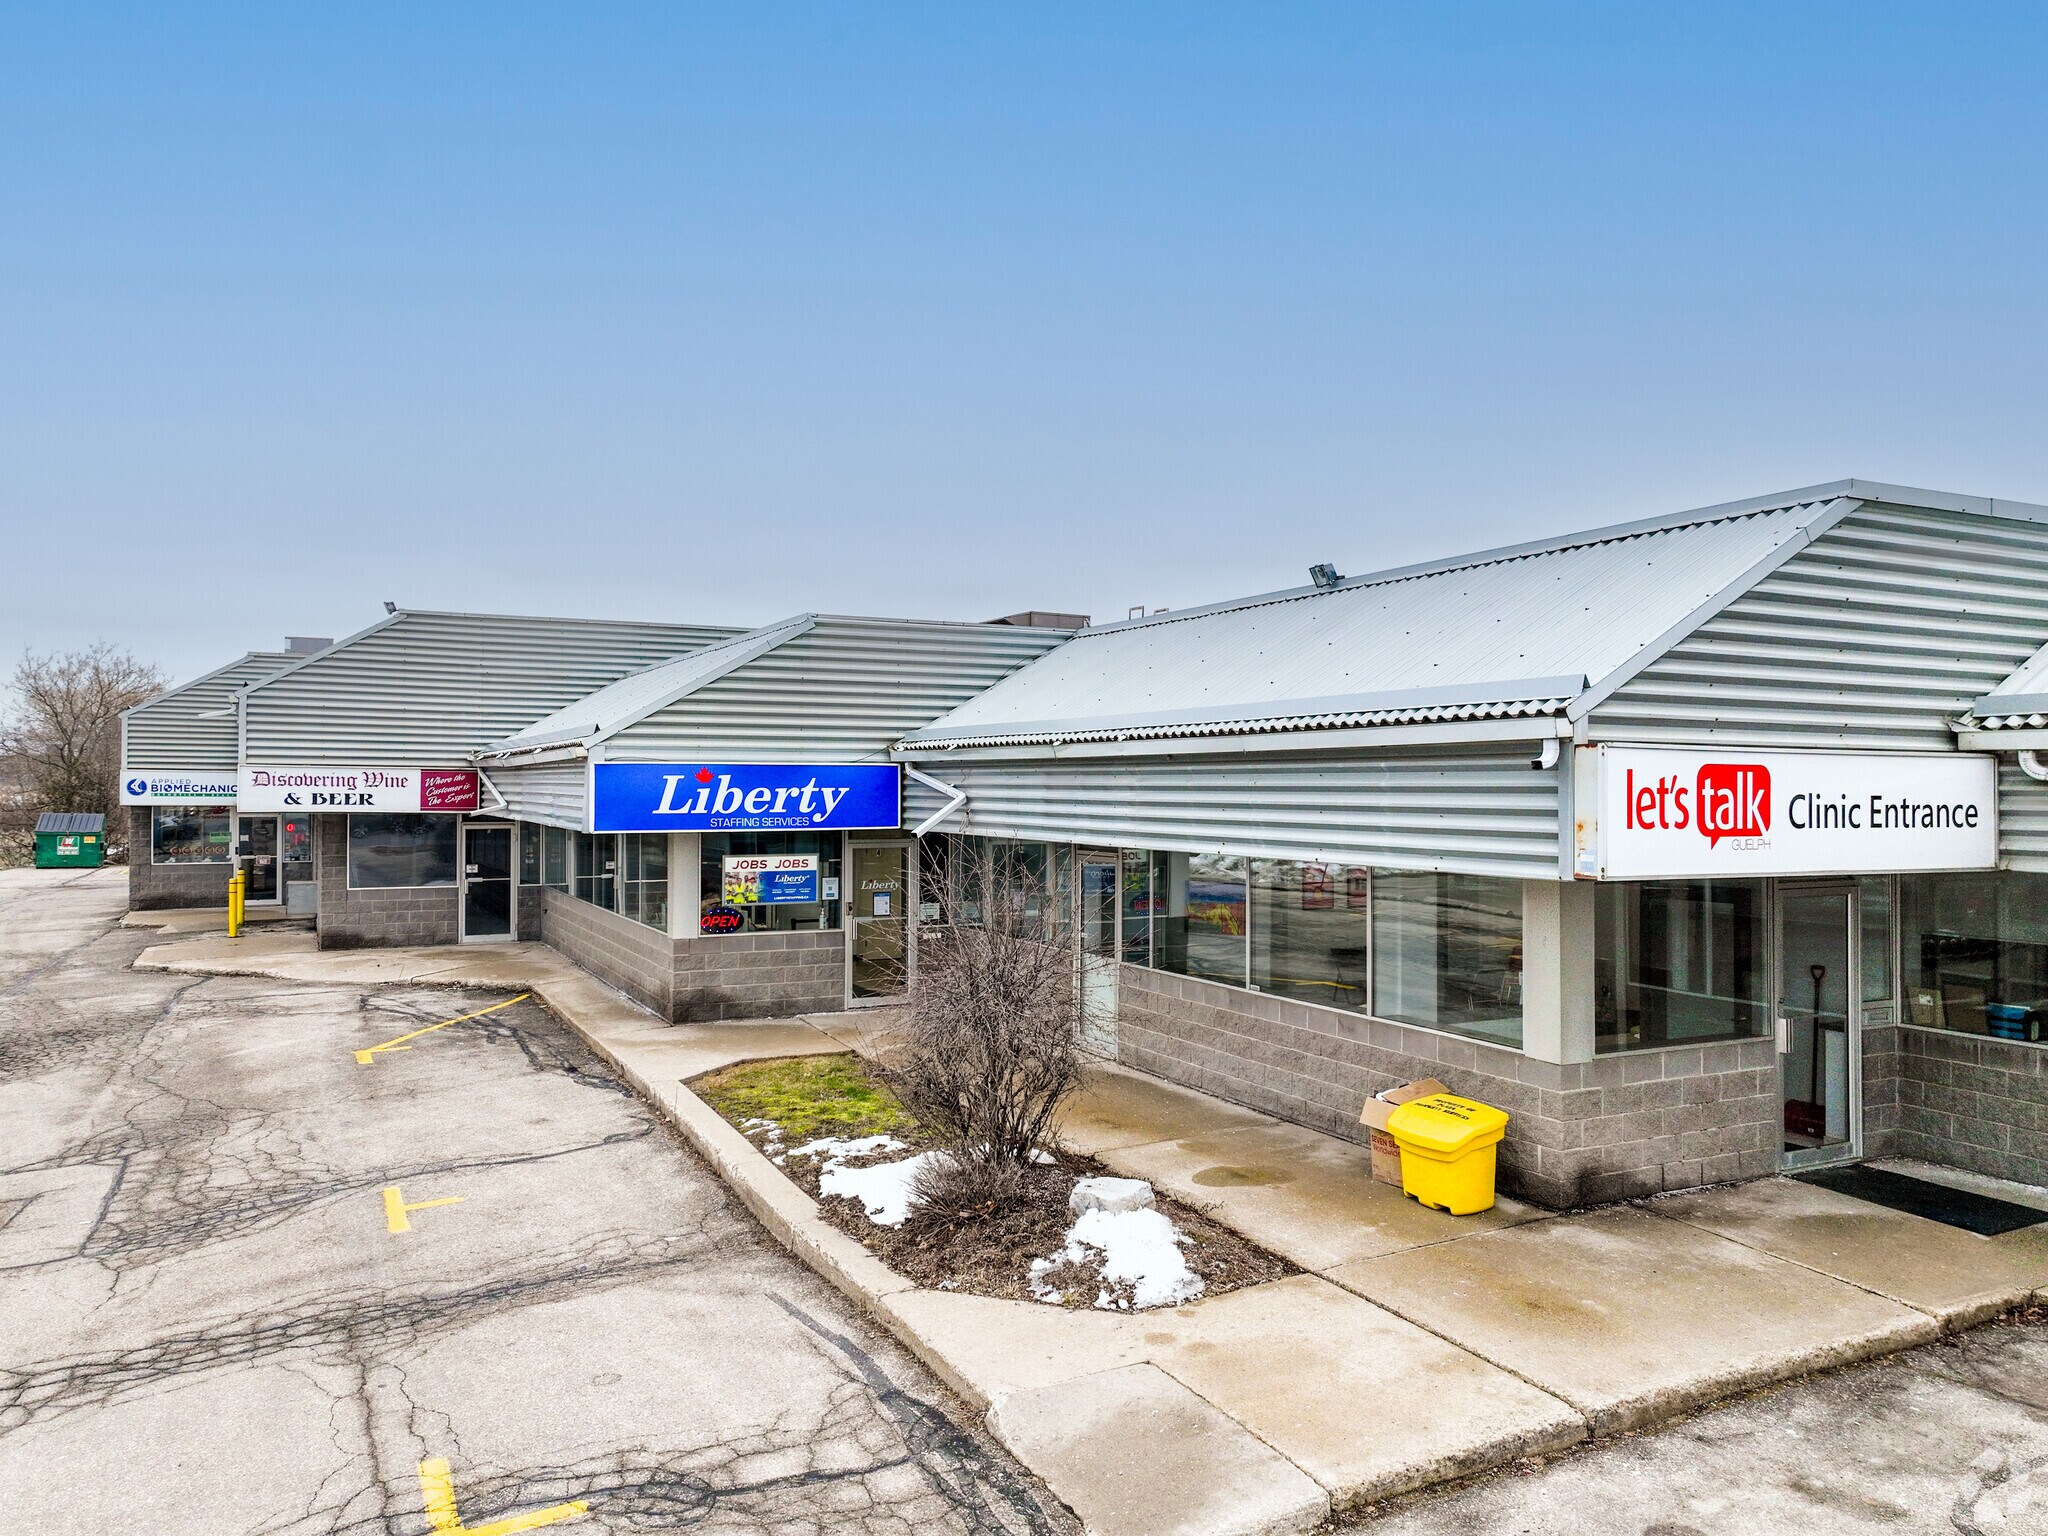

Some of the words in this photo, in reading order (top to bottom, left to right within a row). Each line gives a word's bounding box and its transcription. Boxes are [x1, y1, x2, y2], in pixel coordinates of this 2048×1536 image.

[252, 770, 358, 790] Discovering
[362, 771, 409, 788] Wine
[425, 777, 452, 787] Where
[454, 774, 466, 782] the
[151, 784, 238, 792] BIOMECHANIC
[426, 785, 463, 796] Customer
[284, 793, 303, 805] &
[311, 793, 376, 805] BEER
[428, 797, 442, 806] The
[444, 792, 474, 803] Expert
[652, 767, 850, 823] Liberty
[1626, 768, 1690, 831] let's
[1702, 771, 1765, 837] talk
[1788, 793, 1861, 830] Clinic
[1870, 795, 1979, 830] Entrance
[710, 817, 760, 828] STAFFING
[762, 817, 810, 827] SERVICES
[1731, 838, 1772, 851] GUELPH
[732, 860, 768, 870] JOBS
[774, 859, 809, 868] JOBS
[774, 874, 808, 885] Liberty
[860, 879, 900, 890] Liberty
[701, 915, 740, 927] OPEN
